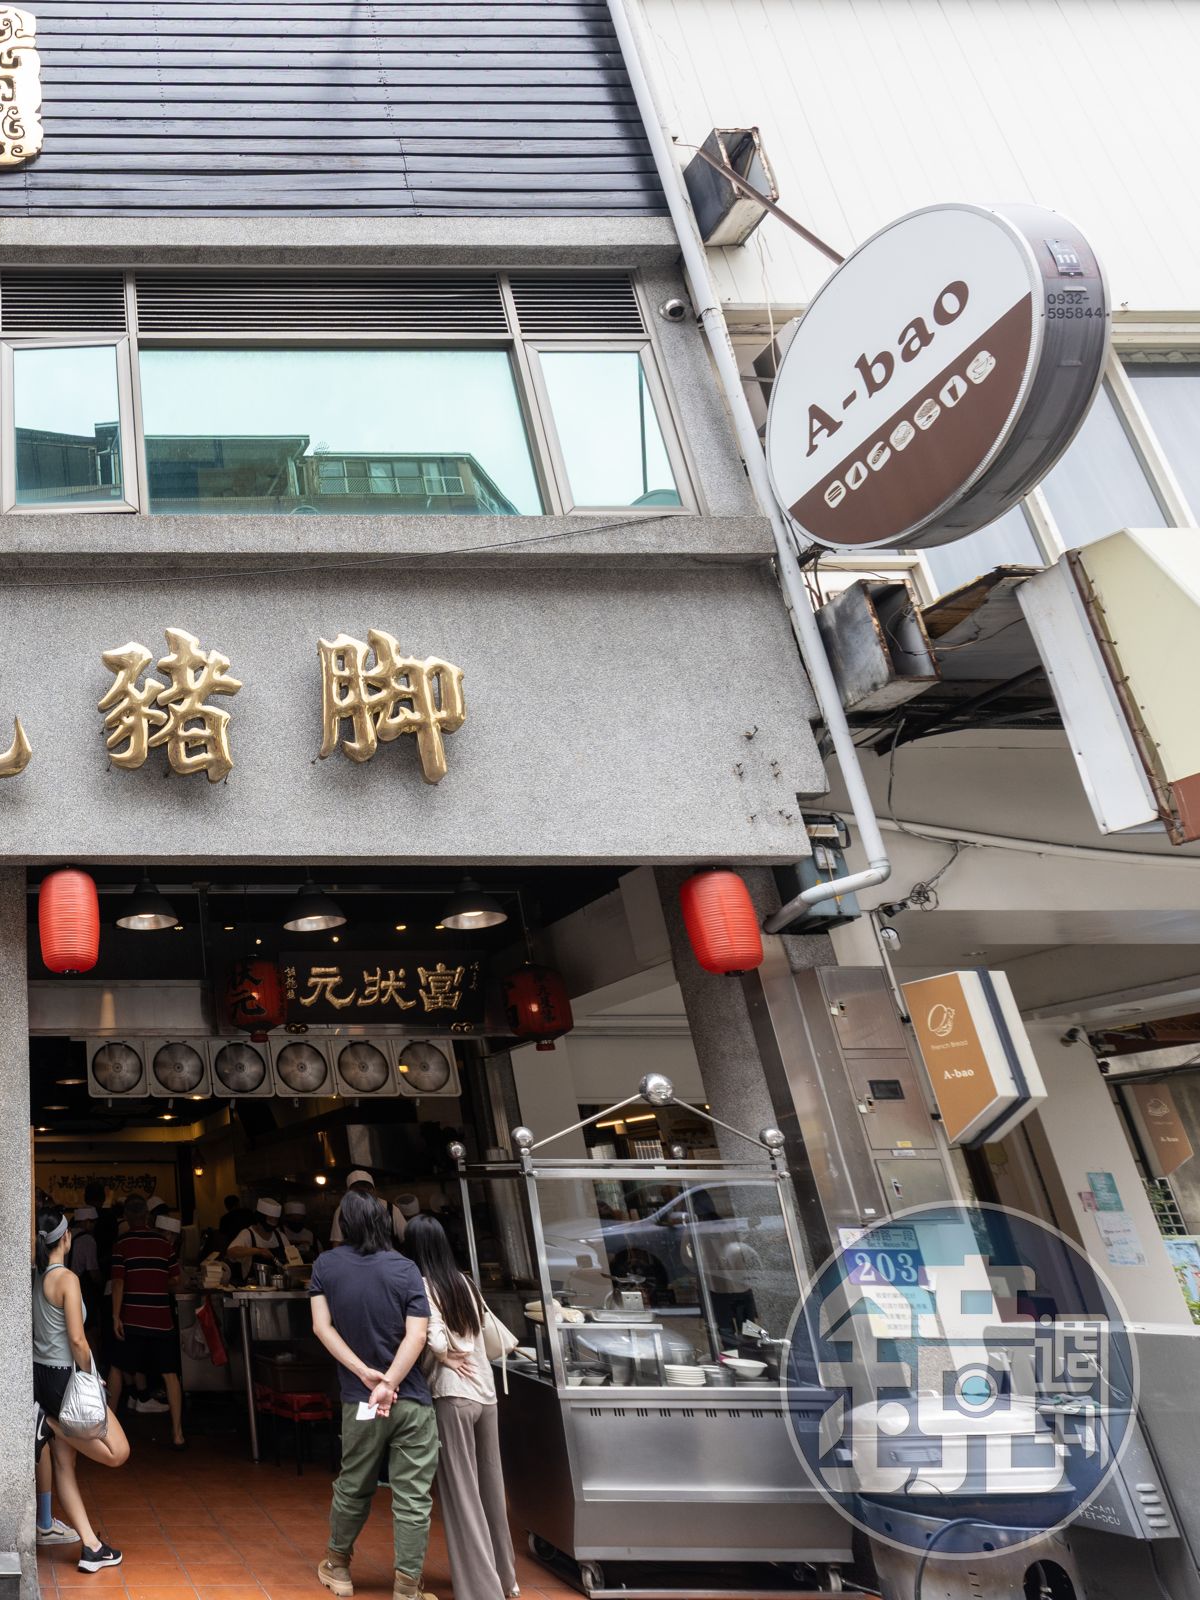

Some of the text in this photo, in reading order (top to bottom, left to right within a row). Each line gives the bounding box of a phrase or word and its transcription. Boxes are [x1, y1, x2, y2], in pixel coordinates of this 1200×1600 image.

[1047, 293, 1090, 304] 0932-
[1047, 307, 1103, 319] 595844
[805, 280, 970, 457] A-bao
[943, 1069, 975, 1080] A-bao
[855, 1252, 918, 1282] 203
